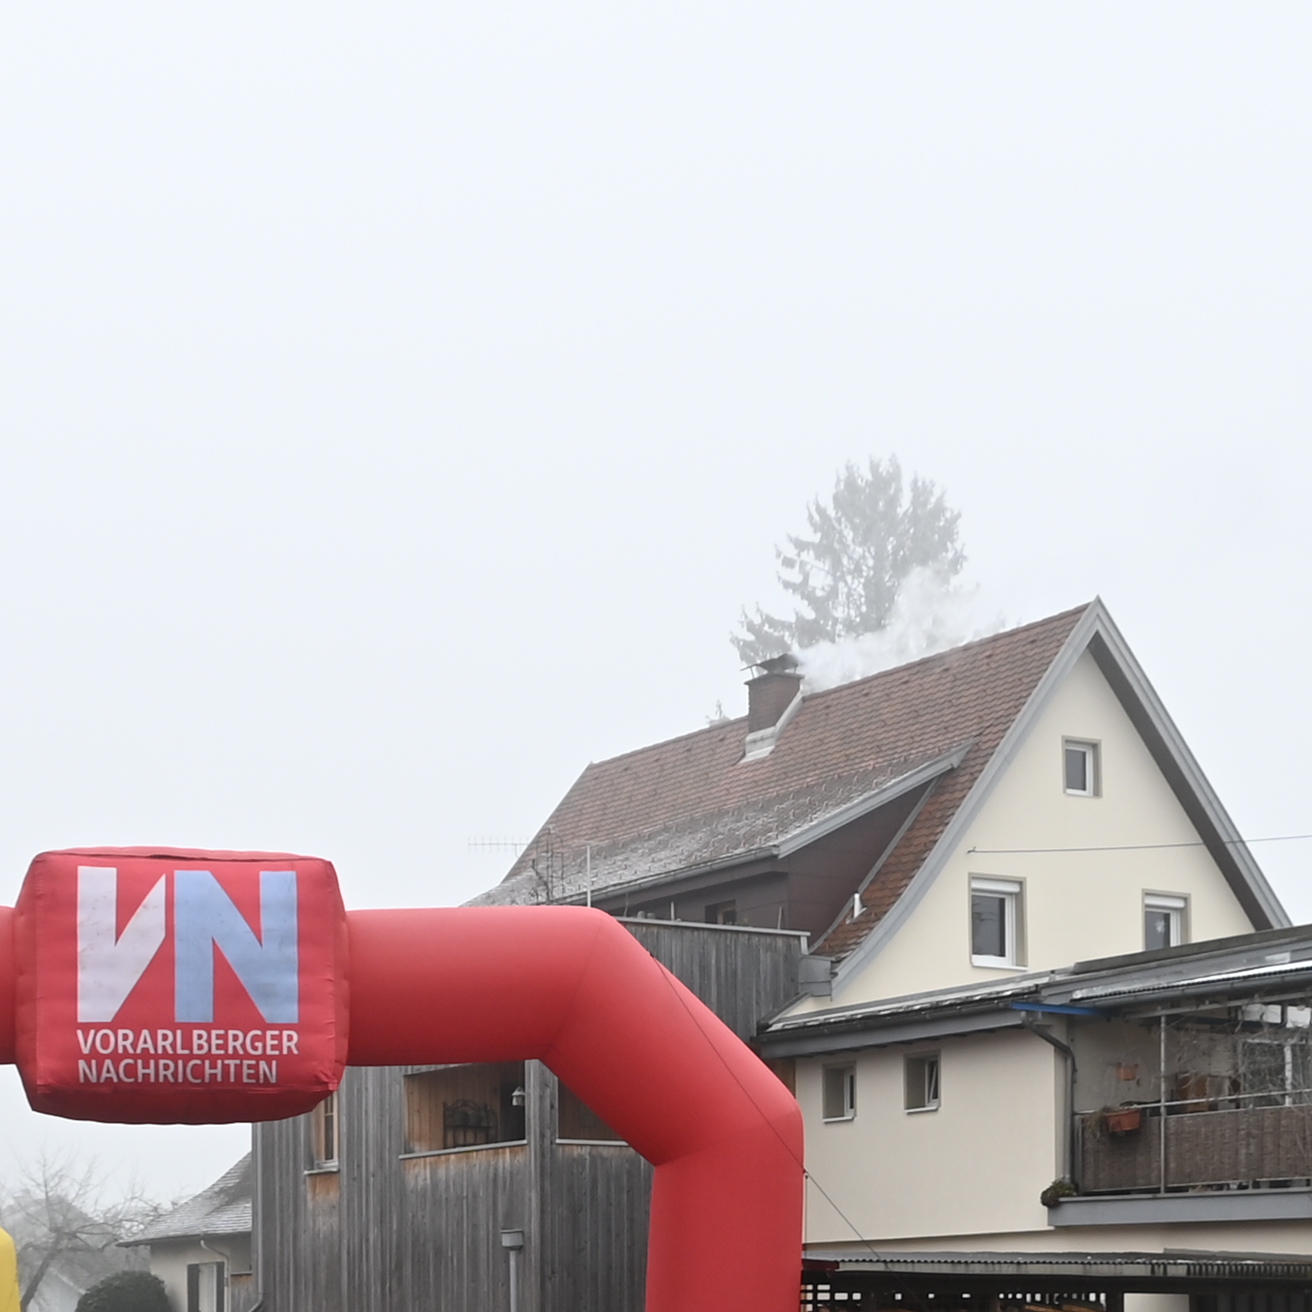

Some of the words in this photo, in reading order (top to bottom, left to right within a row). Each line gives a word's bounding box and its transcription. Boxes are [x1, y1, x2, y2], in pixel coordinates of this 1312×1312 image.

[77, 865, 299, 1024] VN
[76, 1029, 299, 1055] VORARLBERGER
[78, 1059, 278, 1084] NACHRICHTEN
